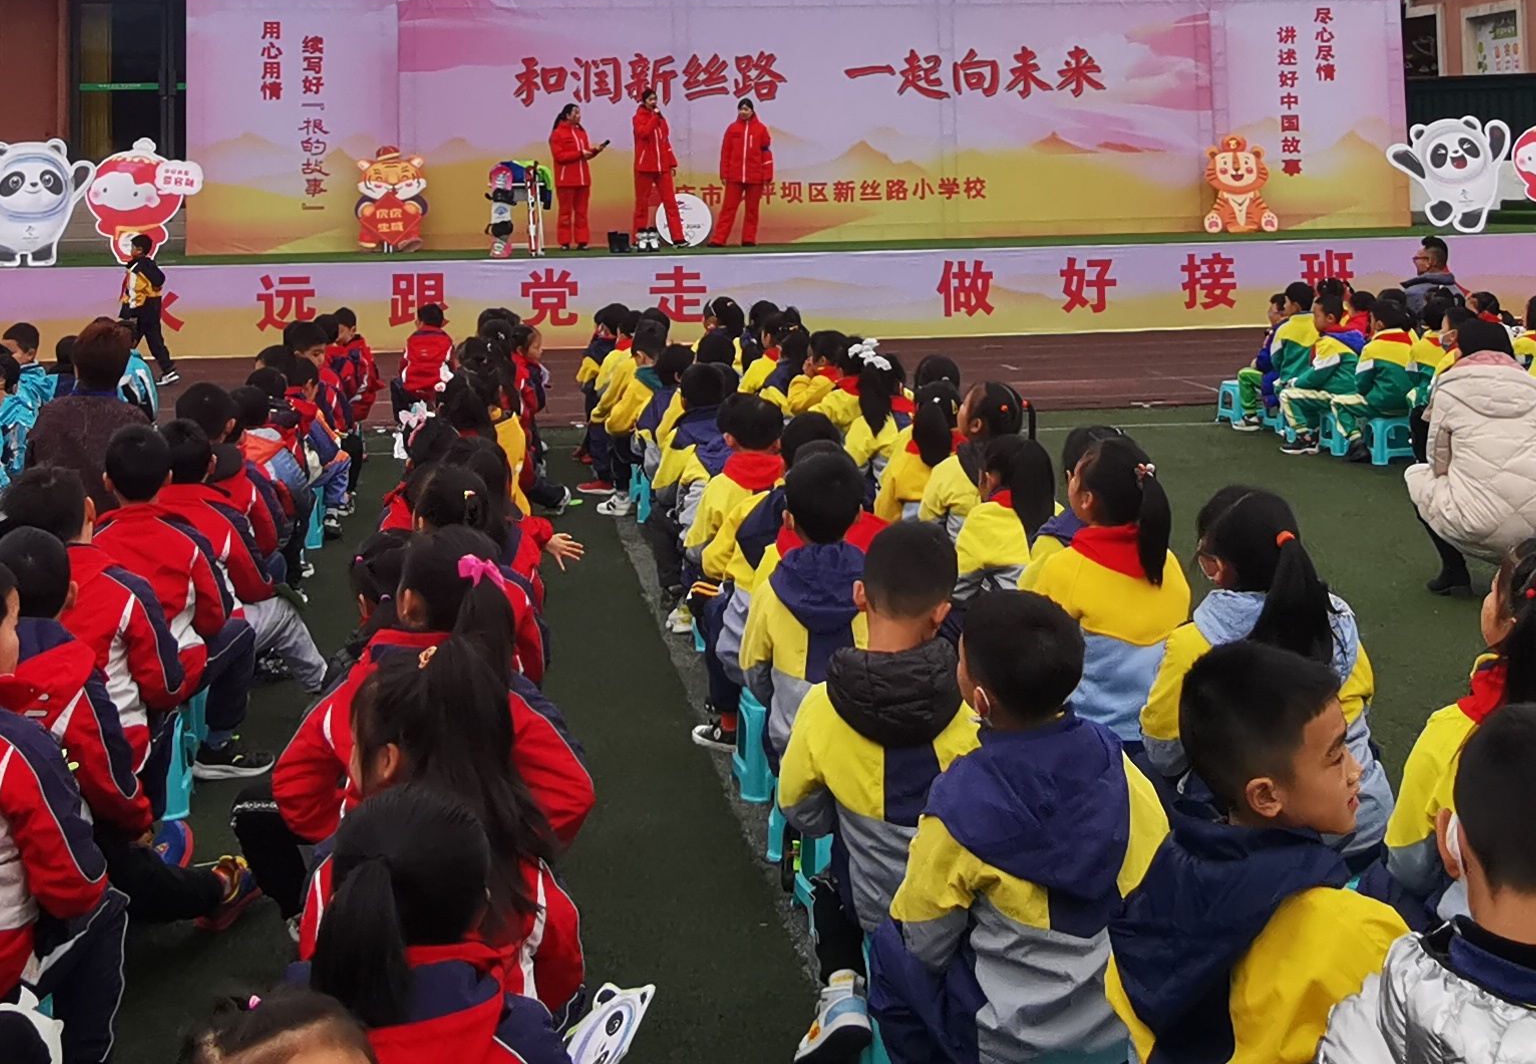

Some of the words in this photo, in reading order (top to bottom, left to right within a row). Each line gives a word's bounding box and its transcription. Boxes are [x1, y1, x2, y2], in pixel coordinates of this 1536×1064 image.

[260, 21, 283, 100] 用心用情
[513, 51, 788, 107] 和润新丝路
[843, 46, 1107, 100] 一起向未来
[1314, 7, 1337, 82] 尽心尽情
[1276, 26, 1303, 177] 讲述好中国故事
